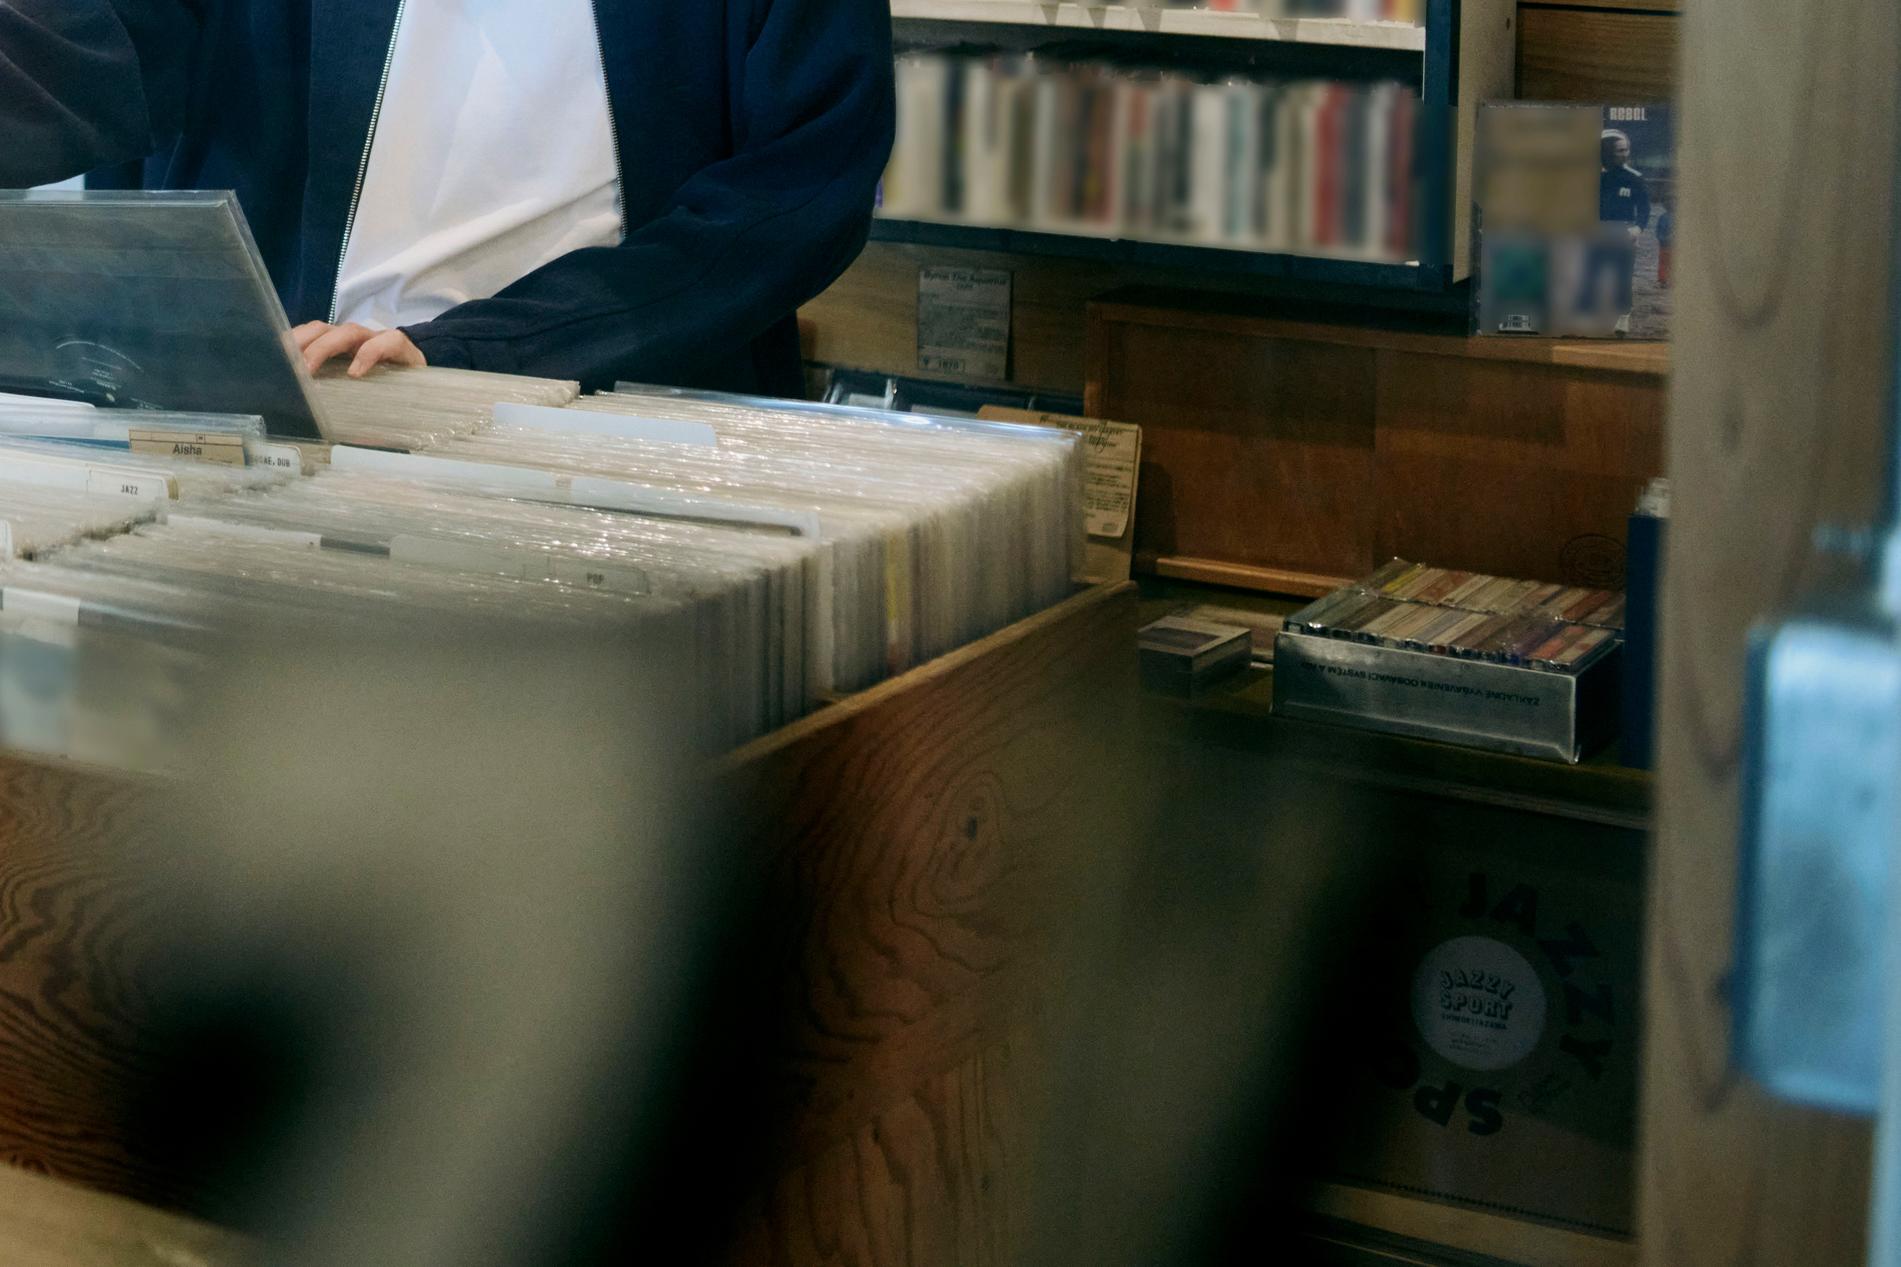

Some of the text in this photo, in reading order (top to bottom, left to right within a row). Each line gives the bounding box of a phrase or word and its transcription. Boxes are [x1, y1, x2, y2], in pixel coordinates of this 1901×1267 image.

[172, 443, 203, 456] Aisha
[120, 485, 139, 496] JAZZ
[587, 573, 604, 585] POP
[1440, 969, 1516, 1002] JAZZY
[1439, 990, 1514, 1022] SPORT
